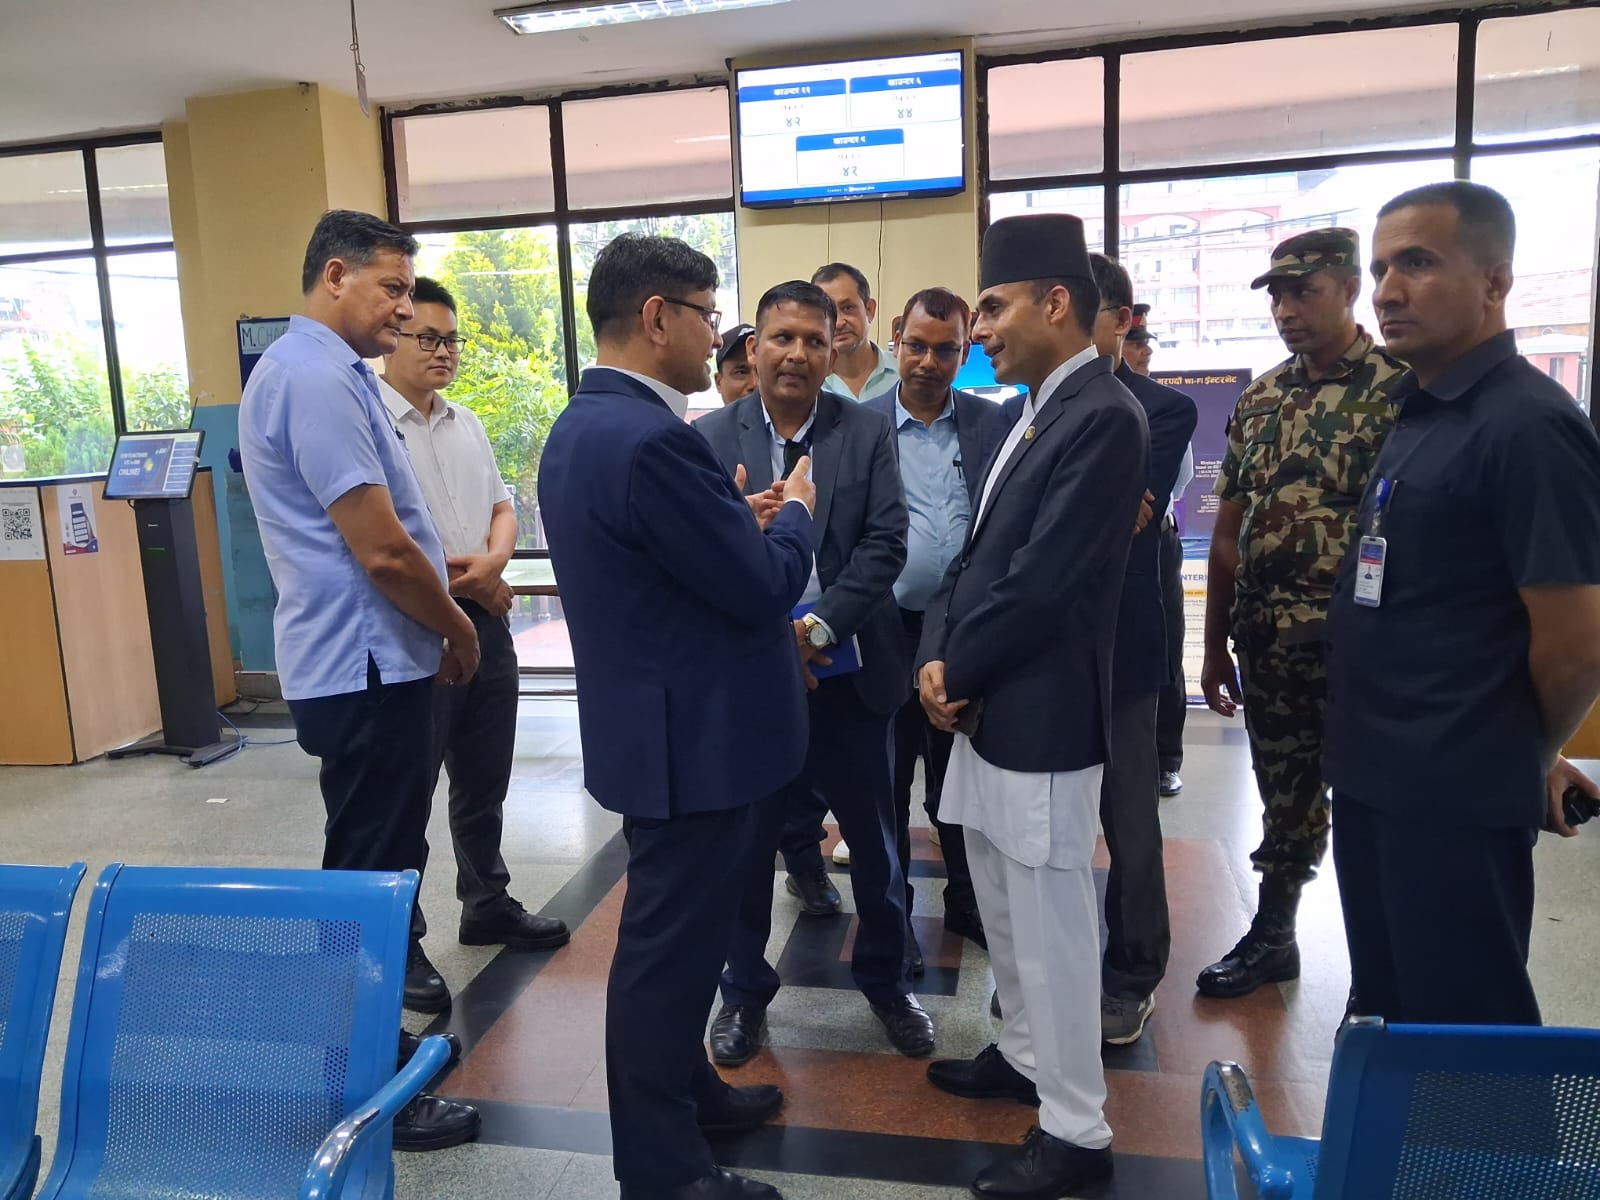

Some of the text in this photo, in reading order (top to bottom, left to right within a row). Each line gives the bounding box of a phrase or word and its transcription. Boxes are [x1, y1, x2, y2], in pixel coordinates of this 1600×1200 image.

[897, 108, 913, 119] ४४
[785, 117, 801, 127] ४२
[842, 166, 858, 177] ४२
